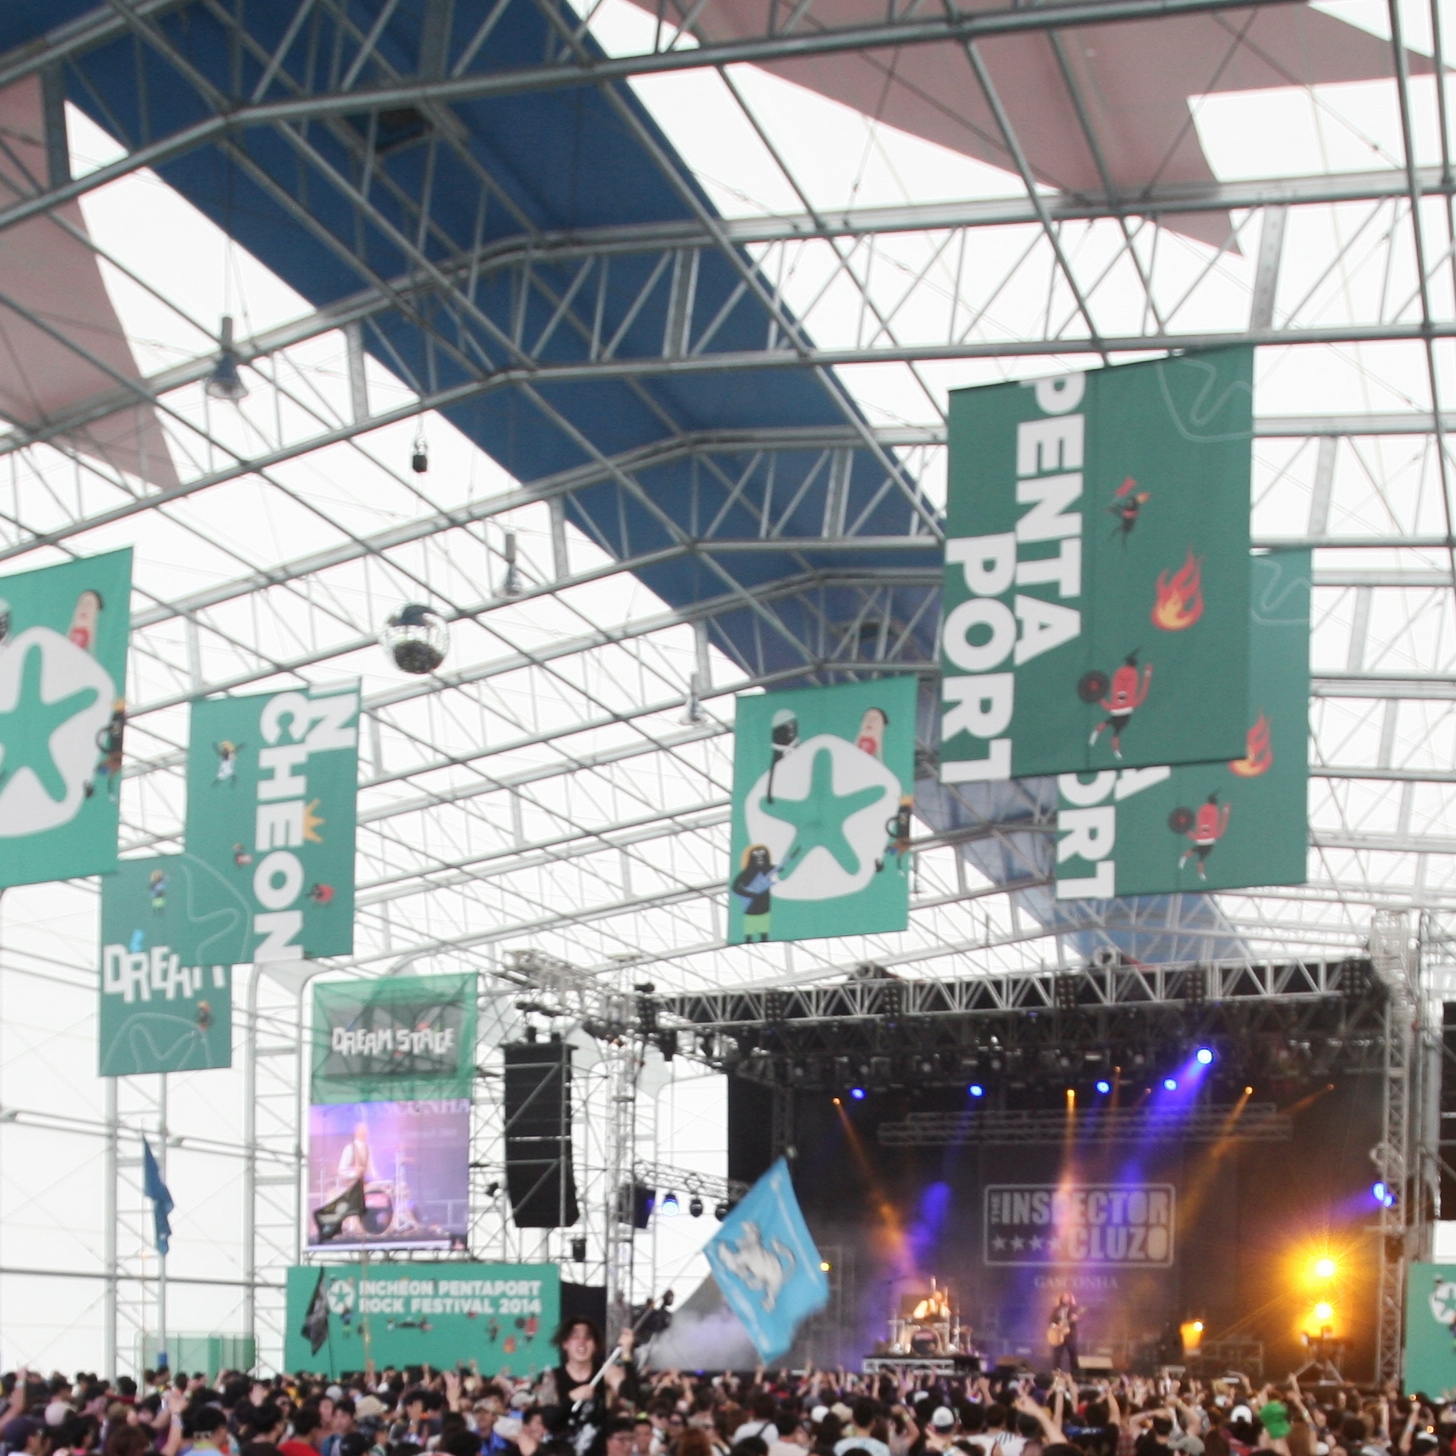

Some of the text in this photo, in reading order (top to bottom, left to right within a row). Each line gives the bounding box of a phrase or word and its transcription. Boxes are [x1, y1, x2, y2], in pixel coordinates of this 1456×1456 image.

[1015, 371, 1086, 666] PENTA
[941, 532, 1018, 783] PORT
[253, 691, 309, 963] CHEON
[332, 1027, 455, 1056] DREAM STAGE
[1002, 1191, 1168, 1225] INSPECTOR
[1067, 1226, 1168, 1261] CLUZO
[359, 1280, 542, 1296] INCHEON PENTAPORT
[359, 1298, 542, 1314] ROCK FESTIVAL 2014
